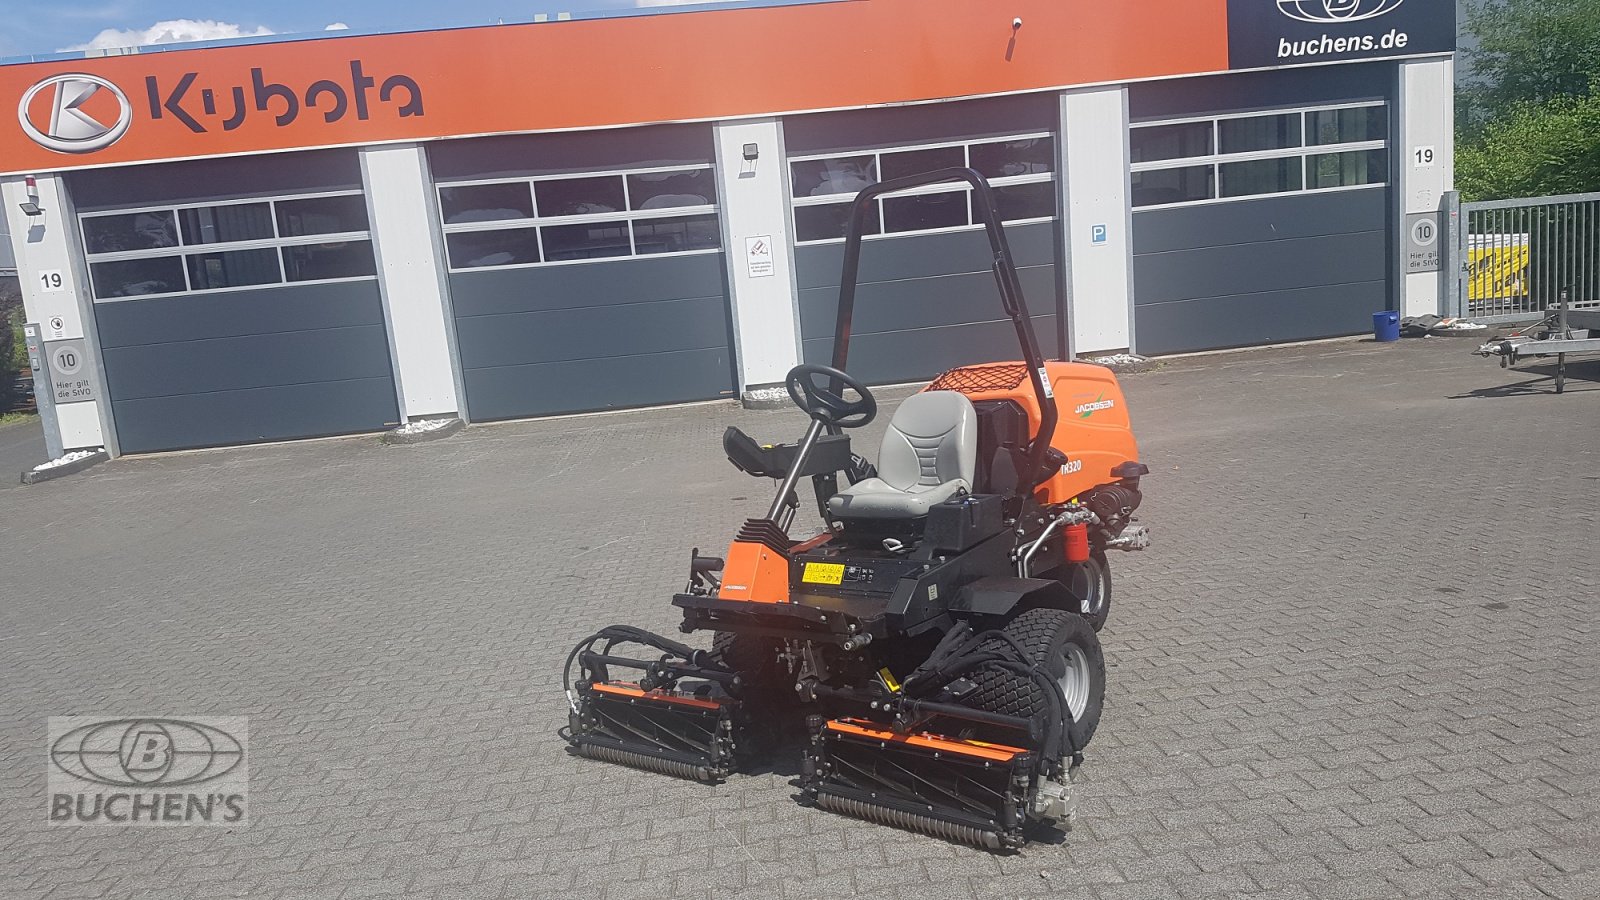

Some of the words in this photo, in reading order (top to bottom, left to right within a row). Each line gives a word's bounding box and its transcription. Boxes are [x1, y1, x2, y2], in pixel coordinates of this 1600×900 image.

[1277, 29, 1408, 58] buchens.de
[145, 60, 424, 133] Kubota
[1415, 149, 1433, 163] 19
[1093, 226, 1105, 241] P
[1418, 226, 1431, 239] 10
[41, 273, 62, 288] 19
[60, 353, 76, 367] 10
[76, 379, 89, 388] gilt
[58, 390, 69, 398] die
[72, 388, 91, 397] StVO
[1075, 400, 1114, 414] JACOBSEN
